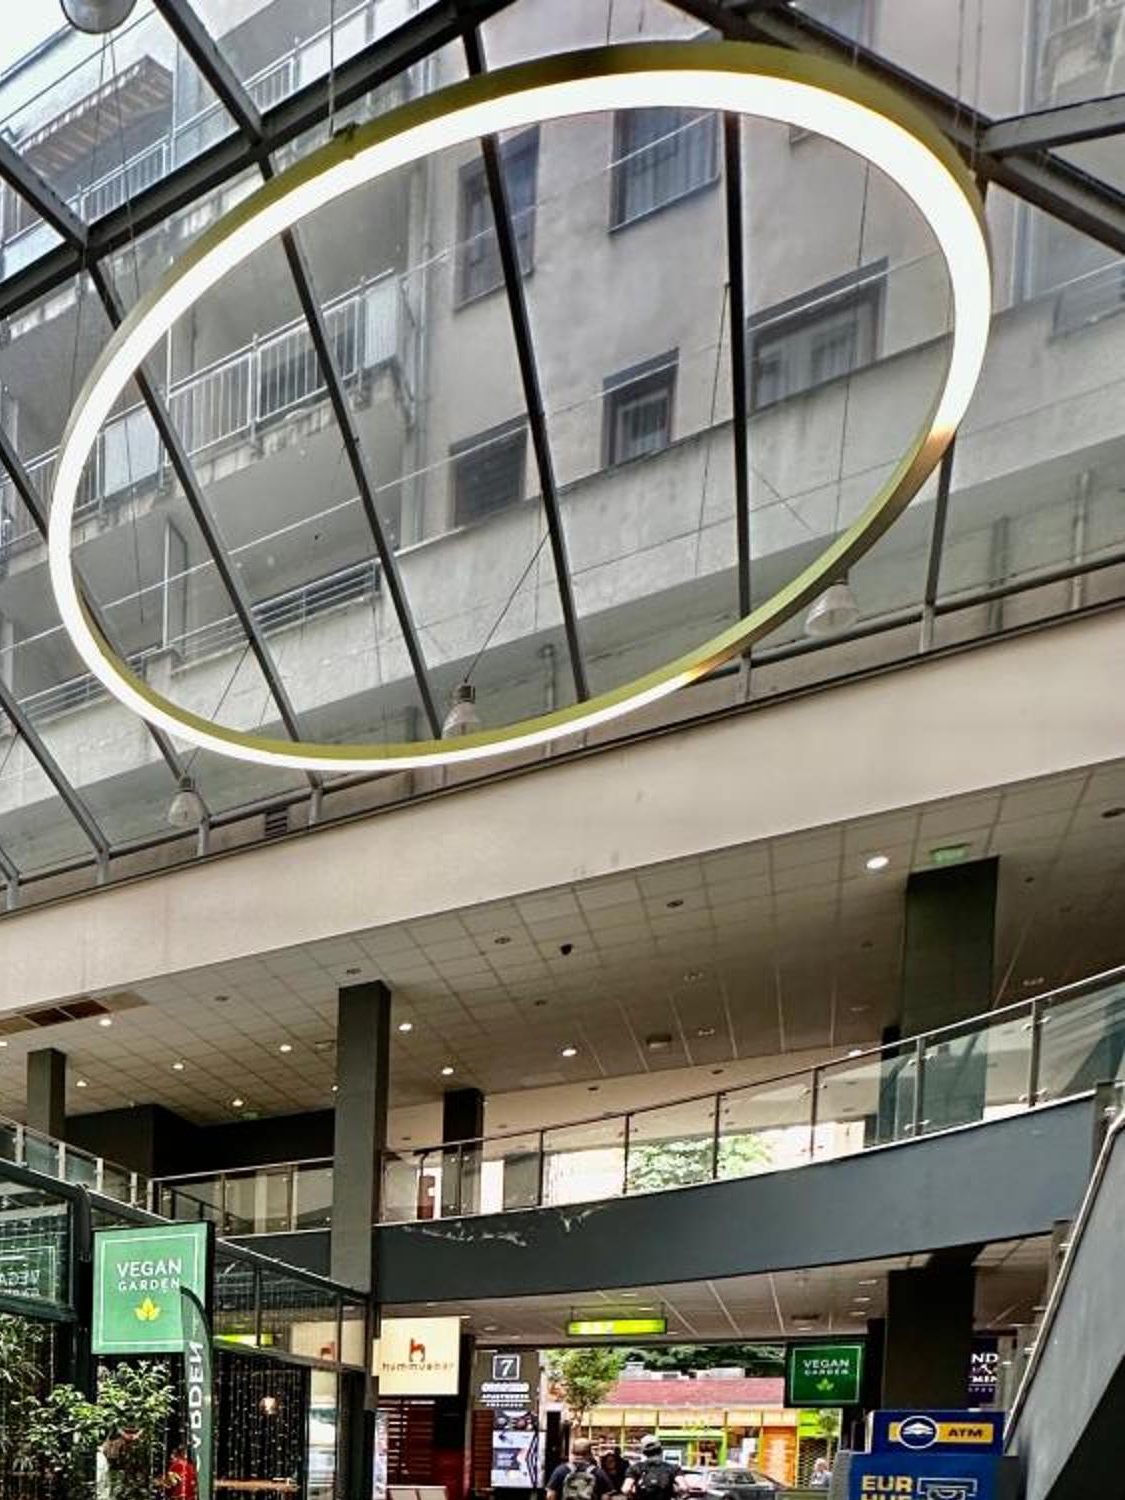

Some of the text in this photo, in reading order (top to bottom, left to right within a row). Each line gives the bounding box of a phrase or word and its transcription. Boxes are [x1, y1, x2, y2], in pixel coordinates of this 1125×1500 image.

[116, 1258, 182, 1277] VEGAN
[118, 1278, 180, 1292] GARDEN
[500, 1359, 514, 1377] 7
[803, 1359, 850, 1369] VEGAN
[948, 1428, 984, 1438] ATM
[861, 1475, 913, 1493] EUR
